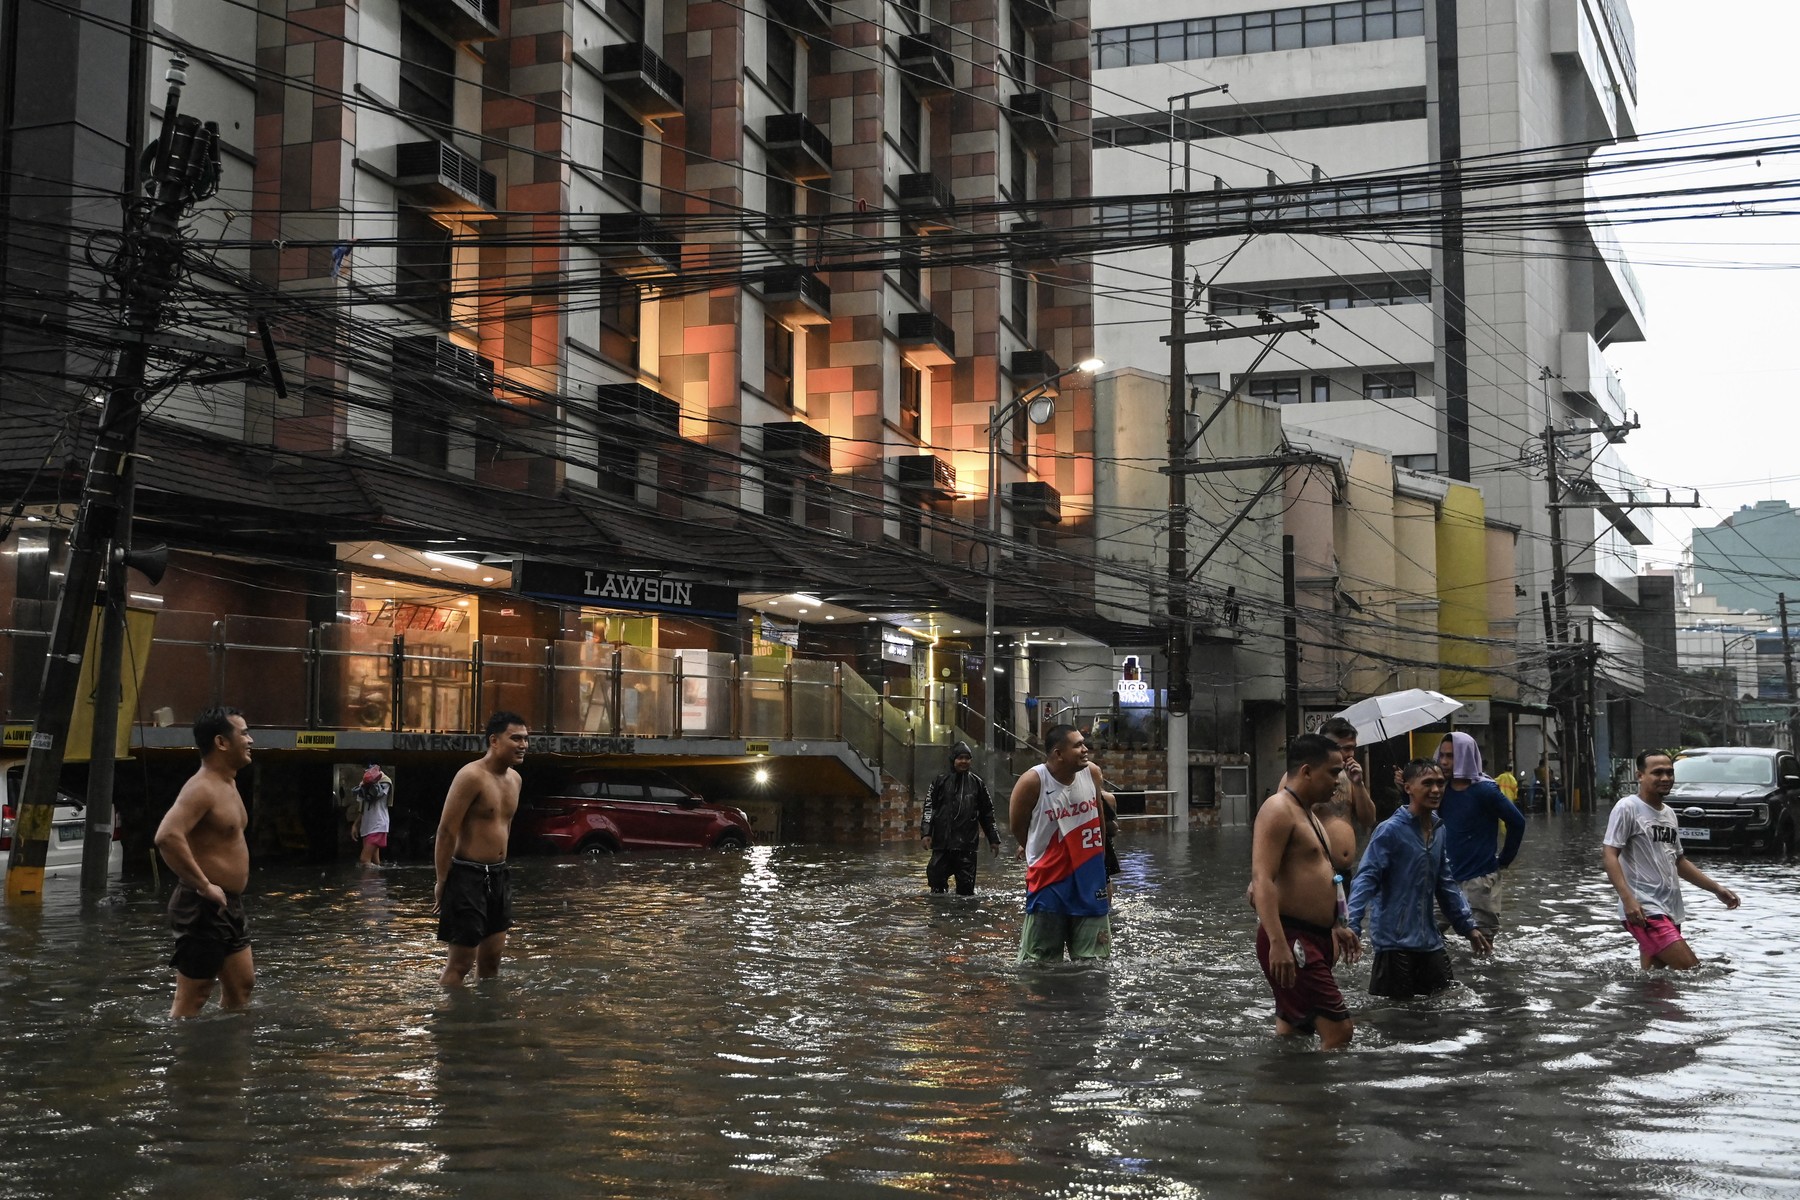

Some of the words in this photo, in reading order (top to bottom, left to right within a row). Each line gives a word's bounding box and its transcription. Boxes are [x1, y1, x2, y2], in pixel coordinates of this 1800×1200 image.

[584, 571, 693, 606] LAWSON
[560, 736, 635, 753] RESIDENCE
[1045, 797, 1099, 821] TUAZON
[1081, 826, 1103, 849] 23
